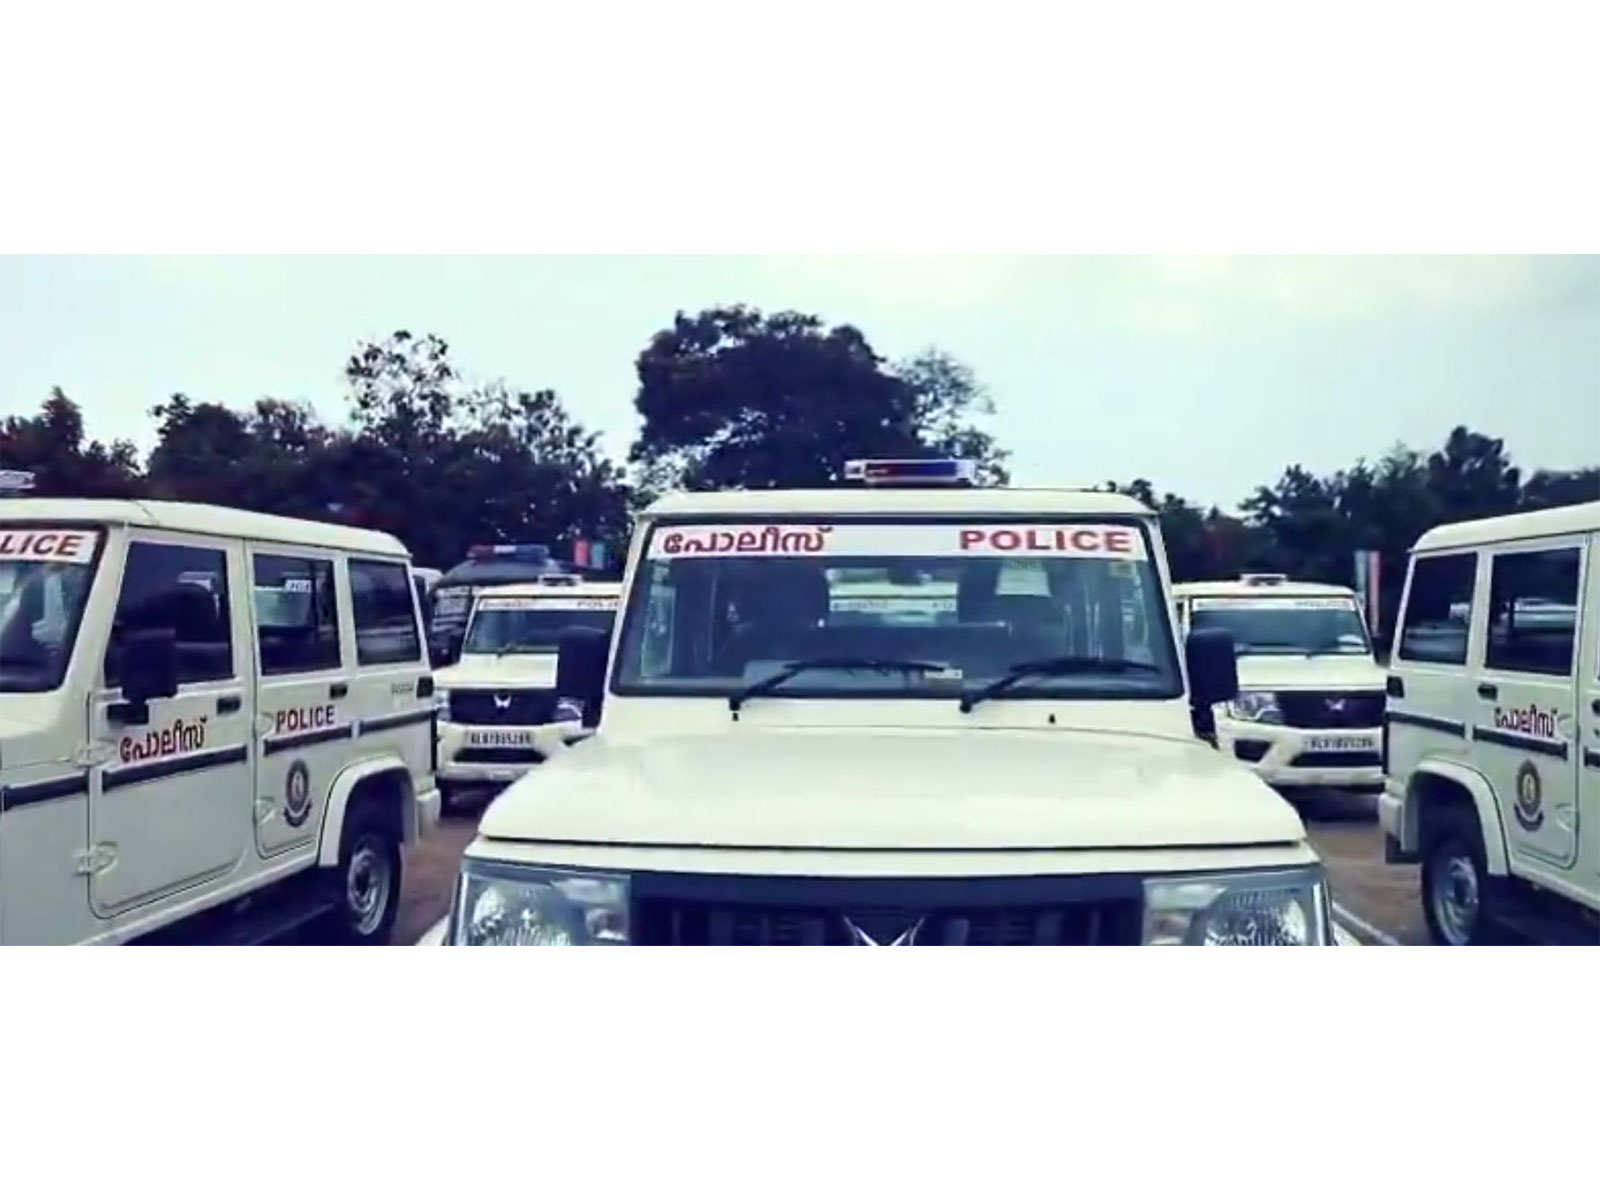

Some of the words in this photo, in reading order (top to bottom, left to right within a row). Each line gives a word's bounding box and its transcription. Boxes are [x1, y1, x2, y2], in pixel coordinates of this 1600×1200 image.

[663, 525, 833, 554] പോലീസ്
[959, 529, 1133, 552] POLICE
[276, 704, 334, 733] POLICE
[119, 714, 208, 763] പോലീസ്
